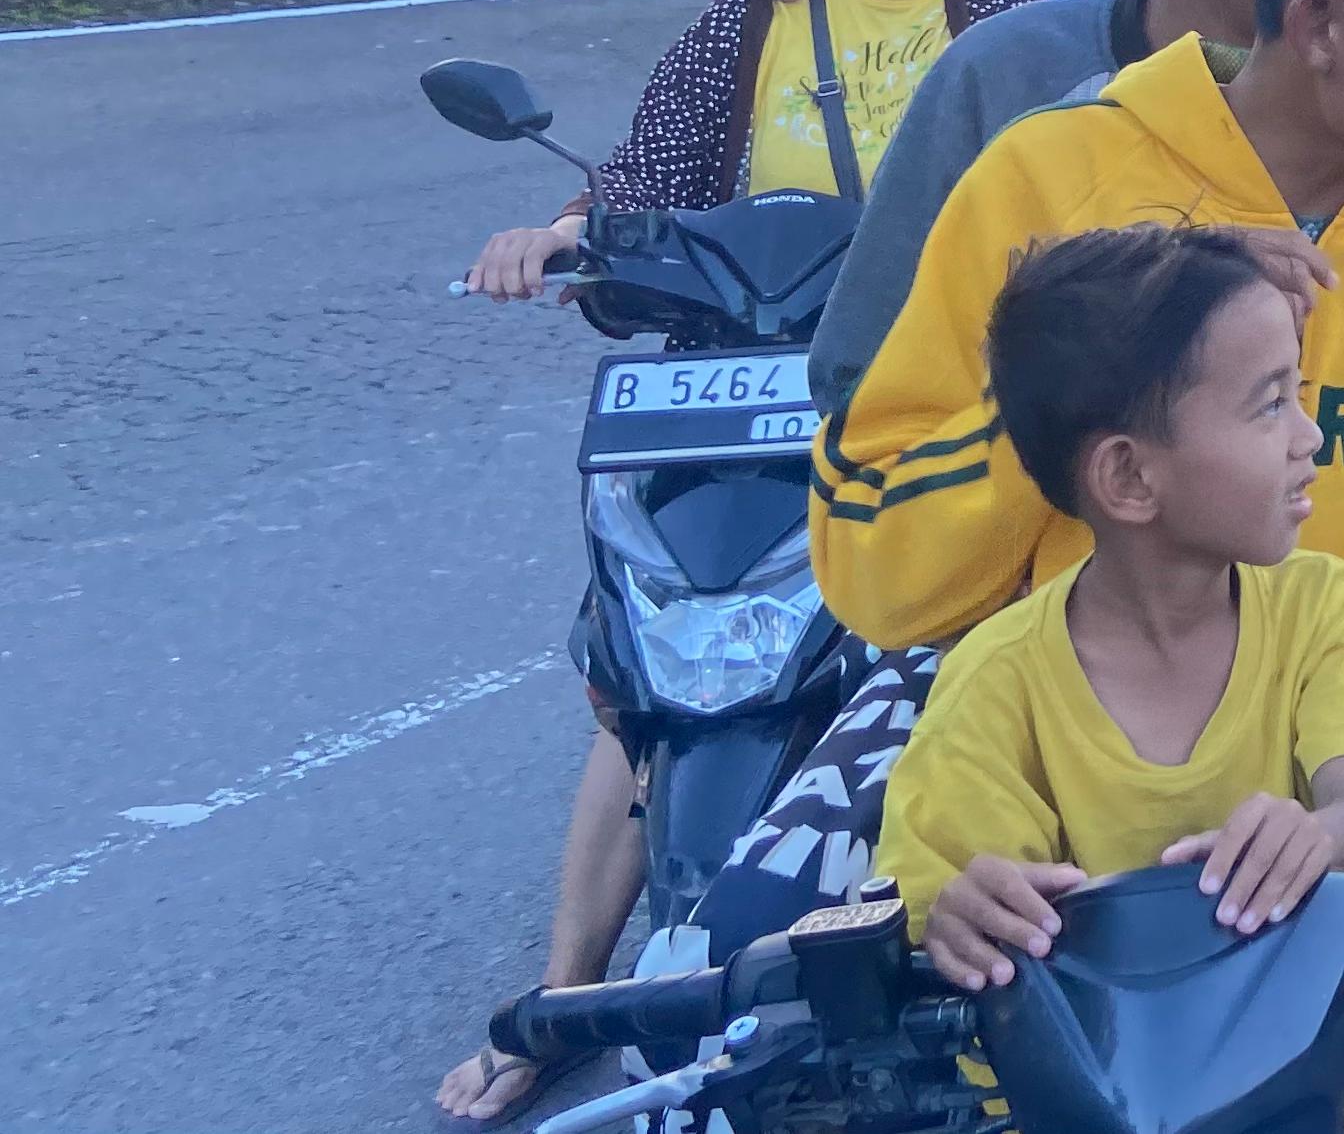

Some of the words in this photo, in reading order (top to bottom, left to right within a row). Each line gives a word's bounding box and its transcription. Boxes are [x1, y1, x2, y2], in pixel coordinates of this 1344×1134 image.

[753, 194, 816, 206] HONDA
[614, 374, 639, 409] B
[670, 364, 782, 406] 5464
